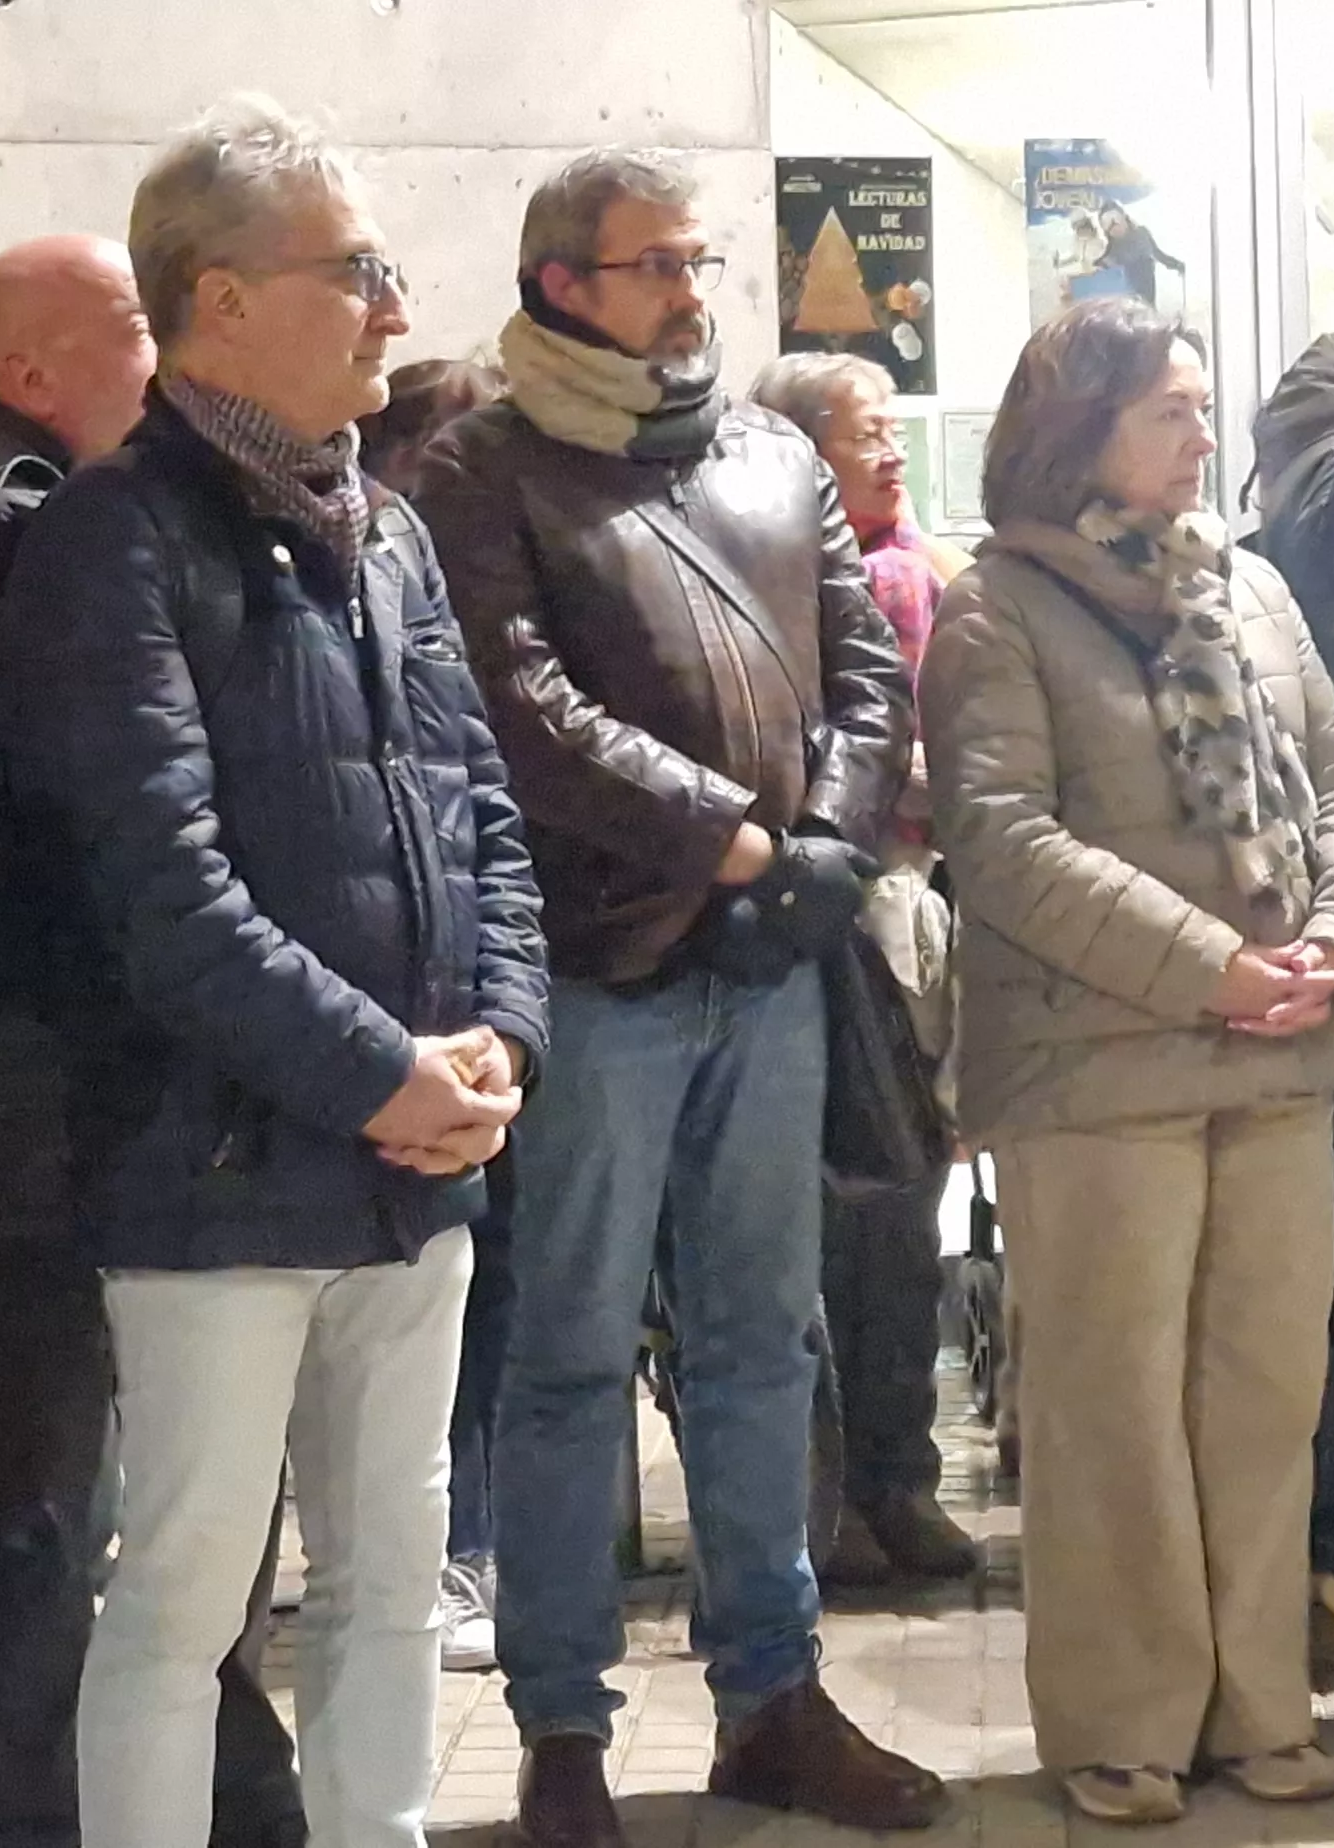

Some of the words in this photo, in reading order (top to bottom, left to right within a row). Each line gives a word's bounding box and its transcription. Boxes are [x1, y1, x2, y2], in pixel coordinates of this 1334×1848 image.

[848, 190, 928, 207] LECTURAS
[880, 212, 902, 229] DE
[856, 233, 926, 251] NAVIDAD
